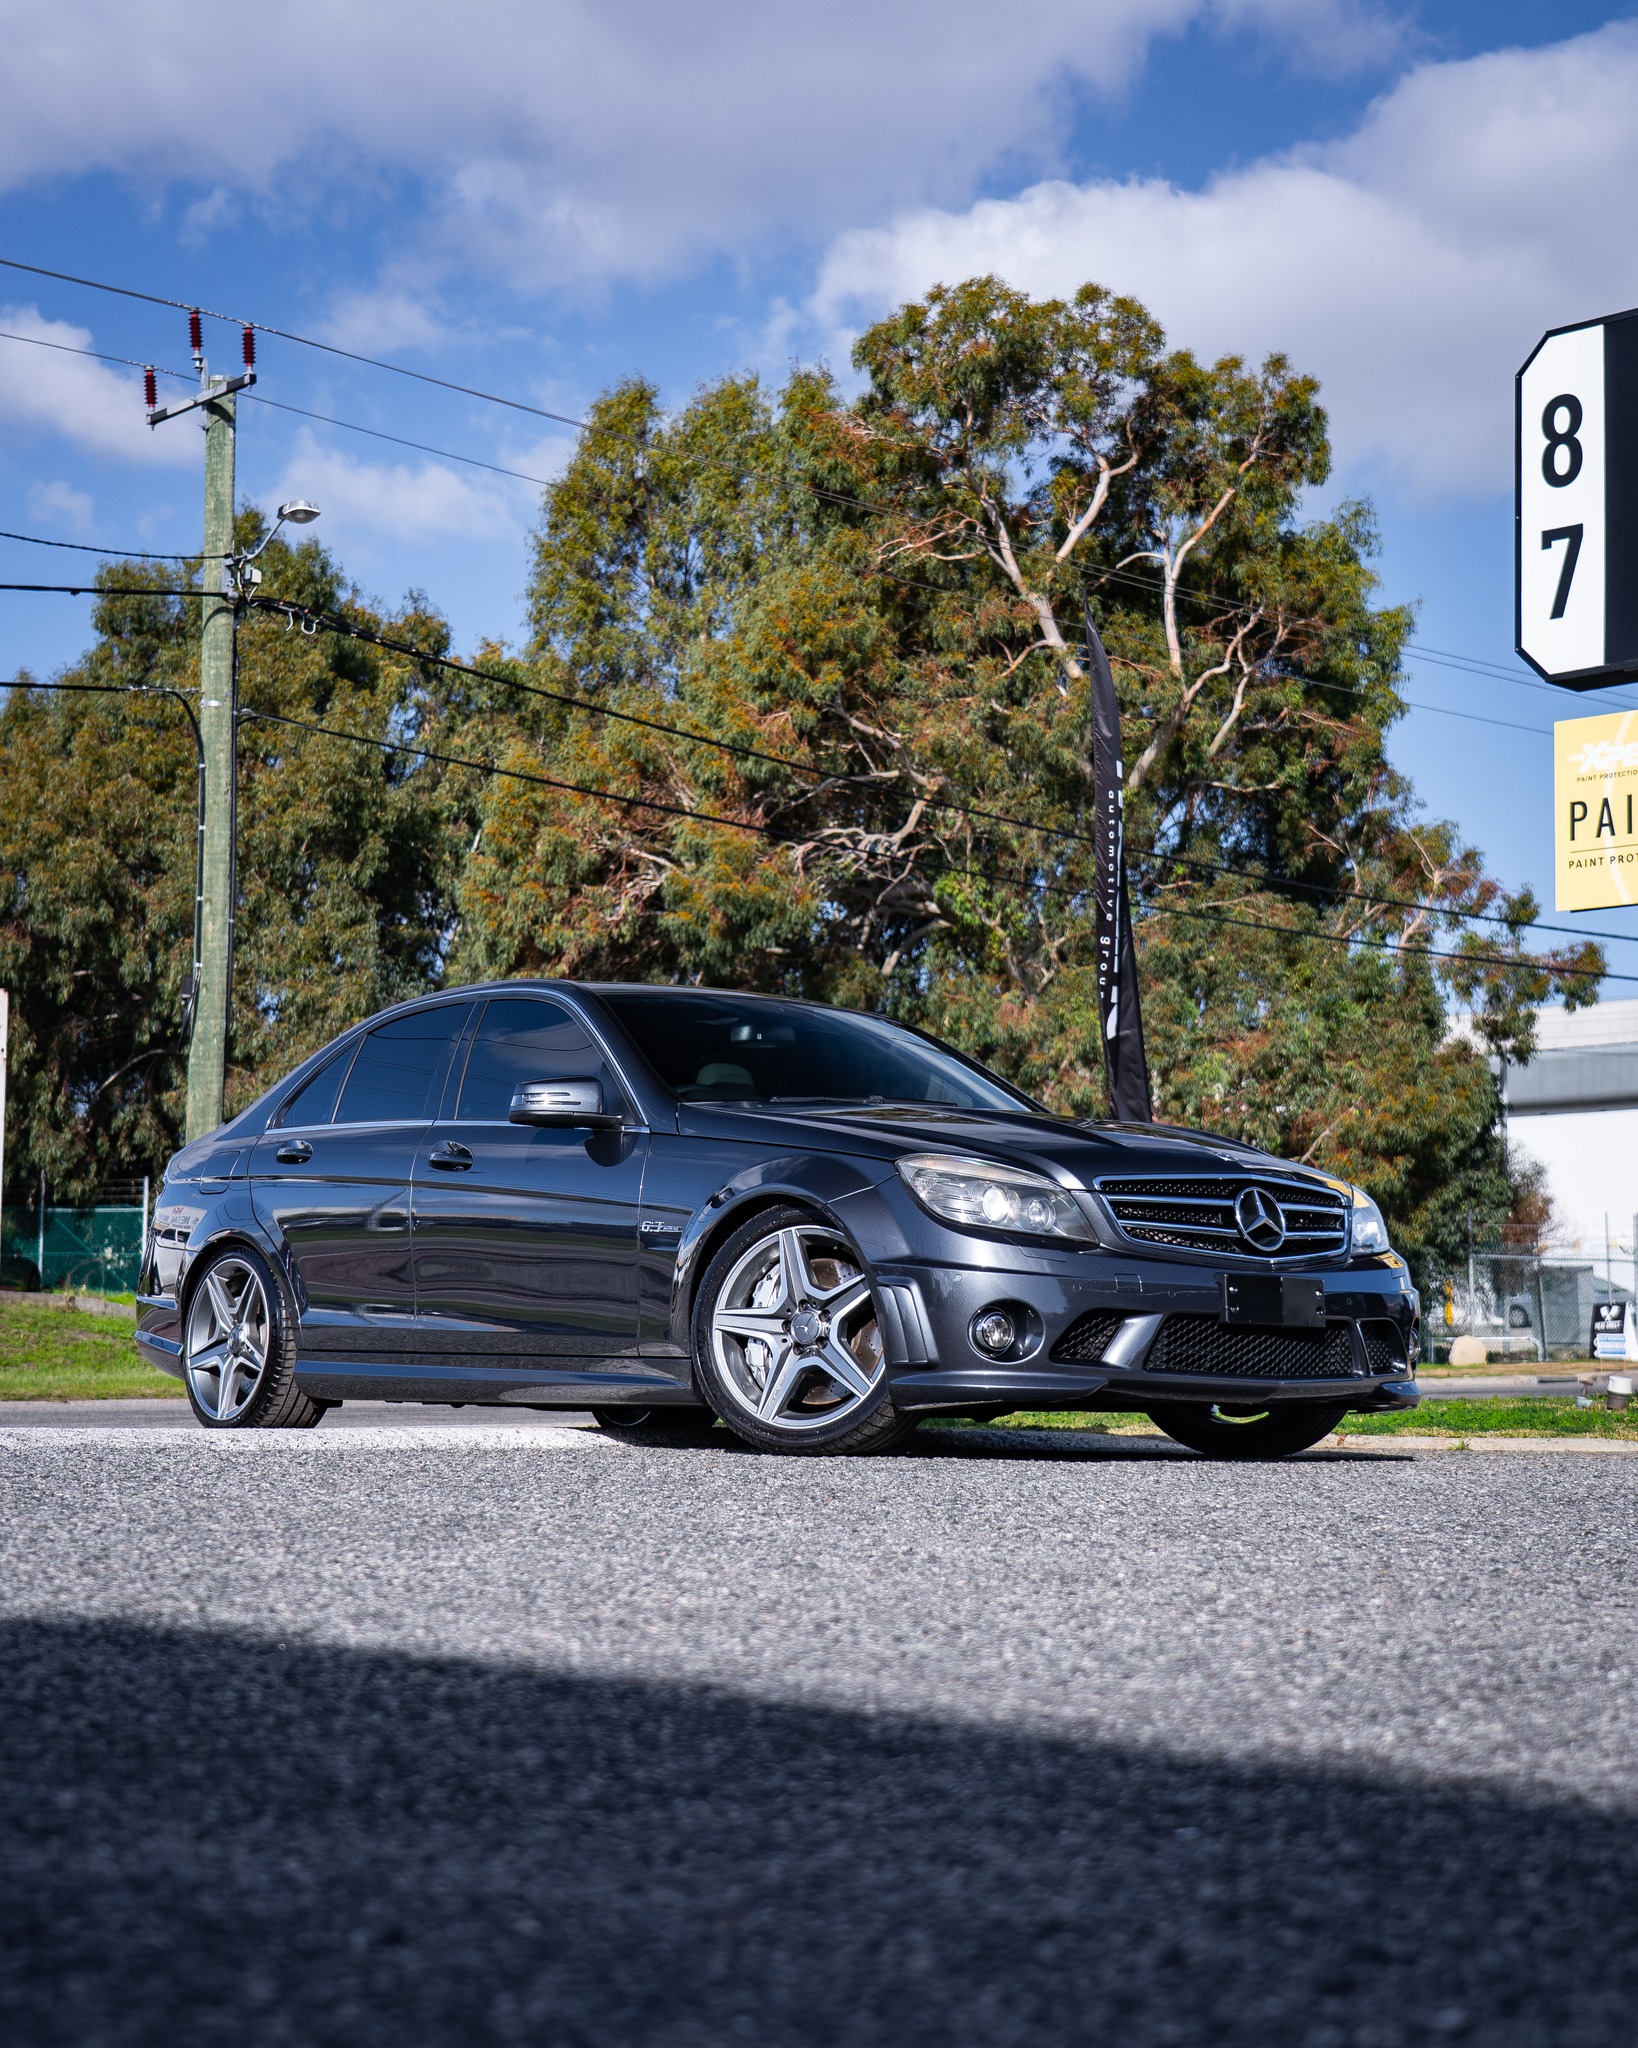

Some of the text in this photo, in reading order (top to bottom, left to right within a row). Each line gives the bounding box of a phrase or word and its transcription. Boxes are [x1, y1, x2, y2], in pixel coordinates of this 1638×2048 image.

[1576, 769, 1638, 783] PAINT PROTECTIO
[1569, 794, 1633, 841] PAI
[1105, 790, 1115, 921] automotive
[1568, 856, 1604, 870] PAINT
